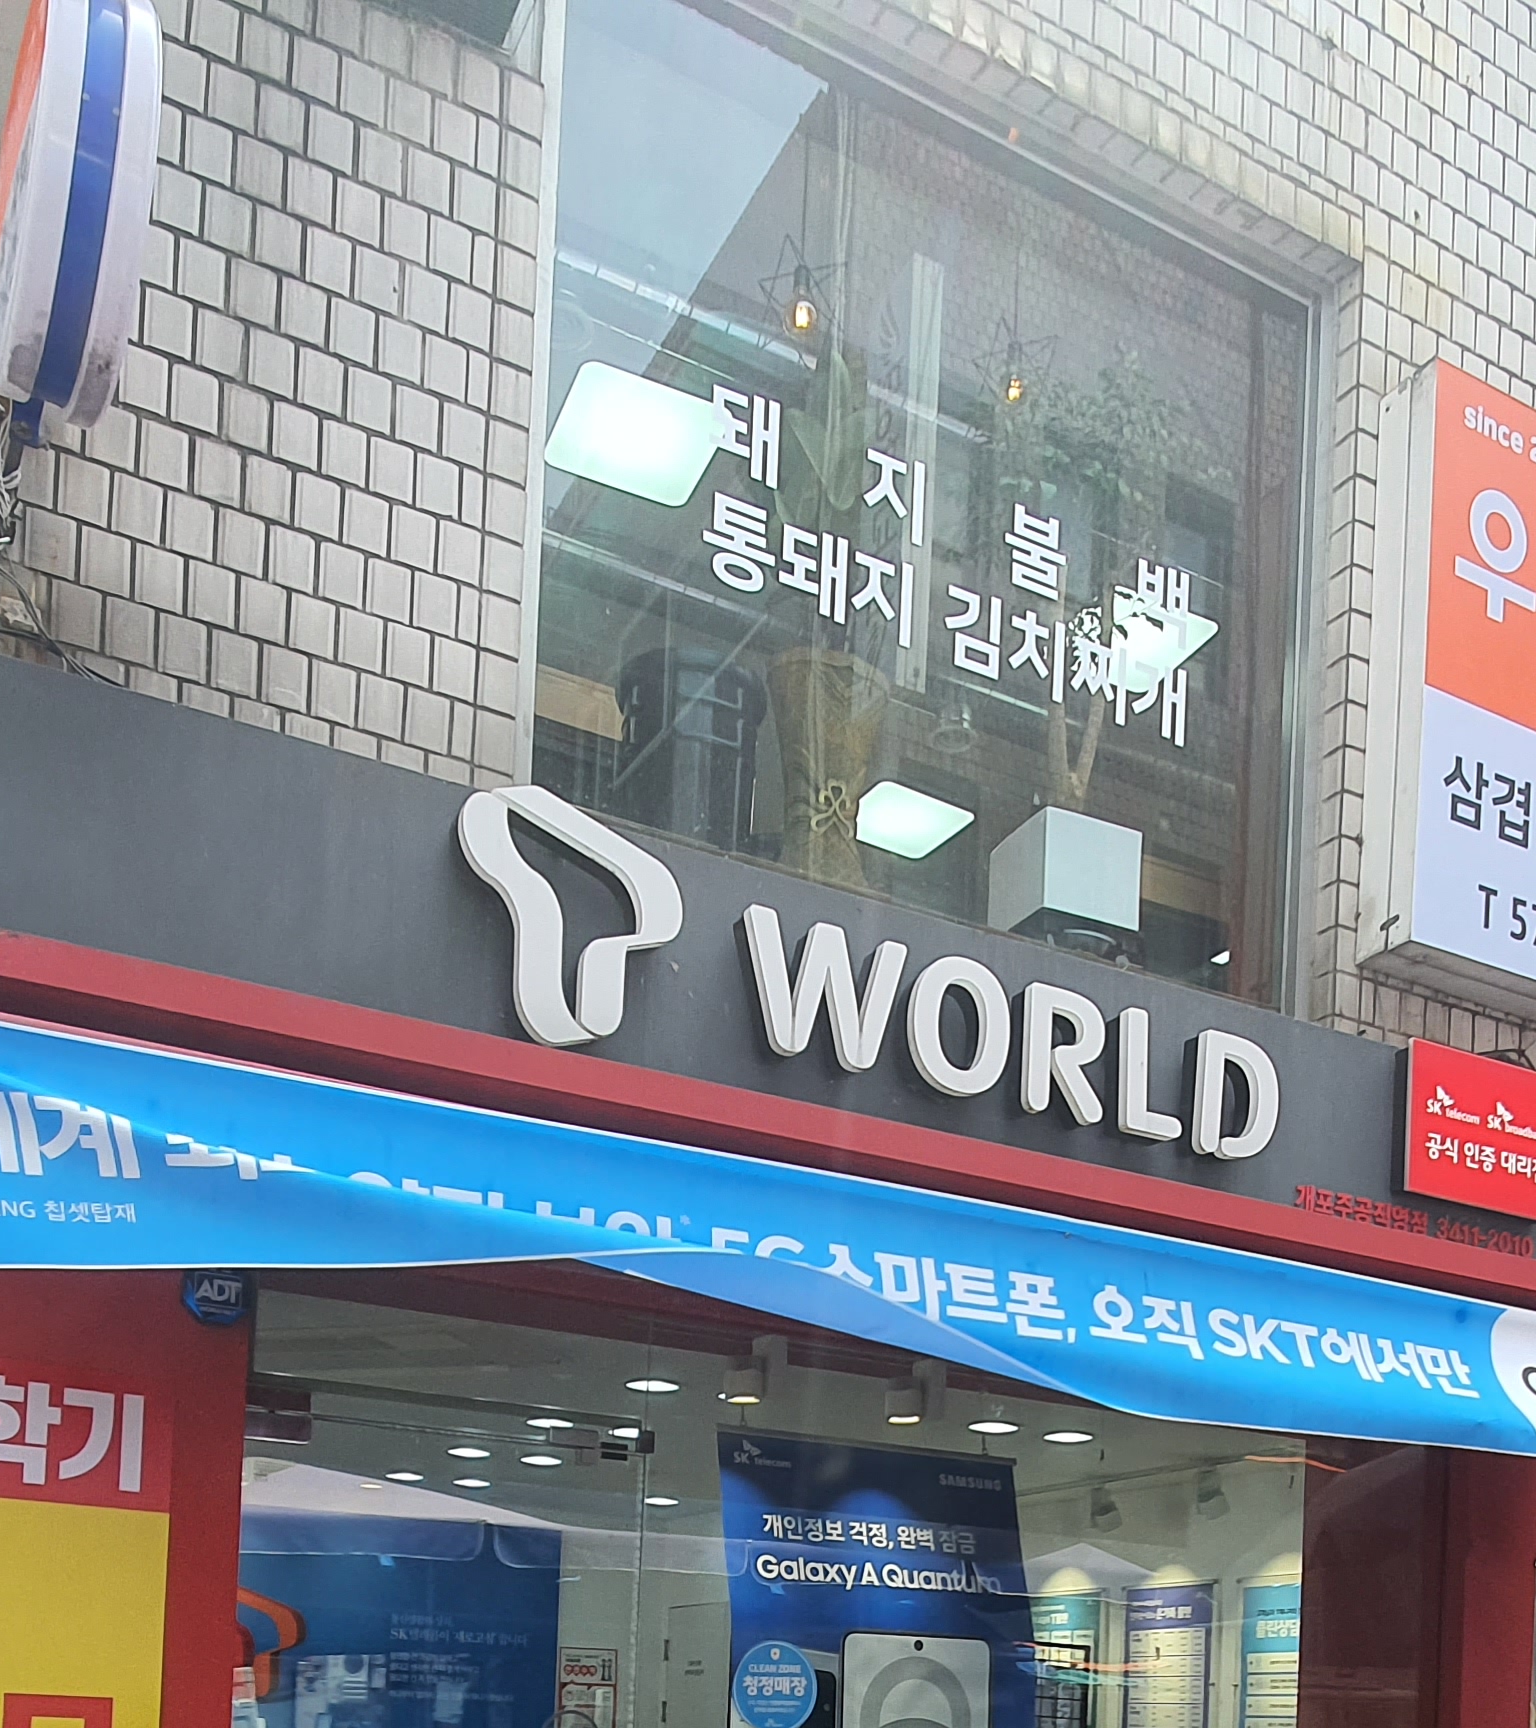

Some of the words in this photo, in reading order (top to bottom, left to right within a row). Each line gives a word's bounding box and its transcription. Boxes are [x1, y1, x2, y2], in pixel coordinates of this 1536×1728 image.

[1463, 405, 1523, 455] since
[703, 492, 914, 648] 통돼지
[1478, 884, 1497, 929] T
[735, 904, 1282, 1161] WORLD
[1426, 1099, 1442, 1116] SK
[1446, 1107, 1480, 1125] telecom
[1486, 1115, 1502, 1131] SK
[1425, 1133, 1459, 1164] 공식
[1464, 1142, 1497, 1173] 인증
[44, 1199, 137, 1224] 칩셋탑재
[1437, 1217, 1534, 1258] 3411-2010
[194, 1282, 243, 1304] ADT
[1088, 1286, 1201, 1361] 오직
[1208, 1307, 1480, 1399] SKT에서만
[938, 1473, 1002, 1491] SAMSUNG
[762, 1514, 845, 1542] 개인정보
[848, 1521, 894, 1550] 걱정,
[896, 1526, 935, 1551] 완벽
[938, 1529, 977, 1555] 잠금
[756, 1554, 858, 1591] Galaxy
[860, 1563, 880, 1586] A
[882, 1564, 1001, 1594] Quantum
[742, 1675, 807, 1697] 청정매장
